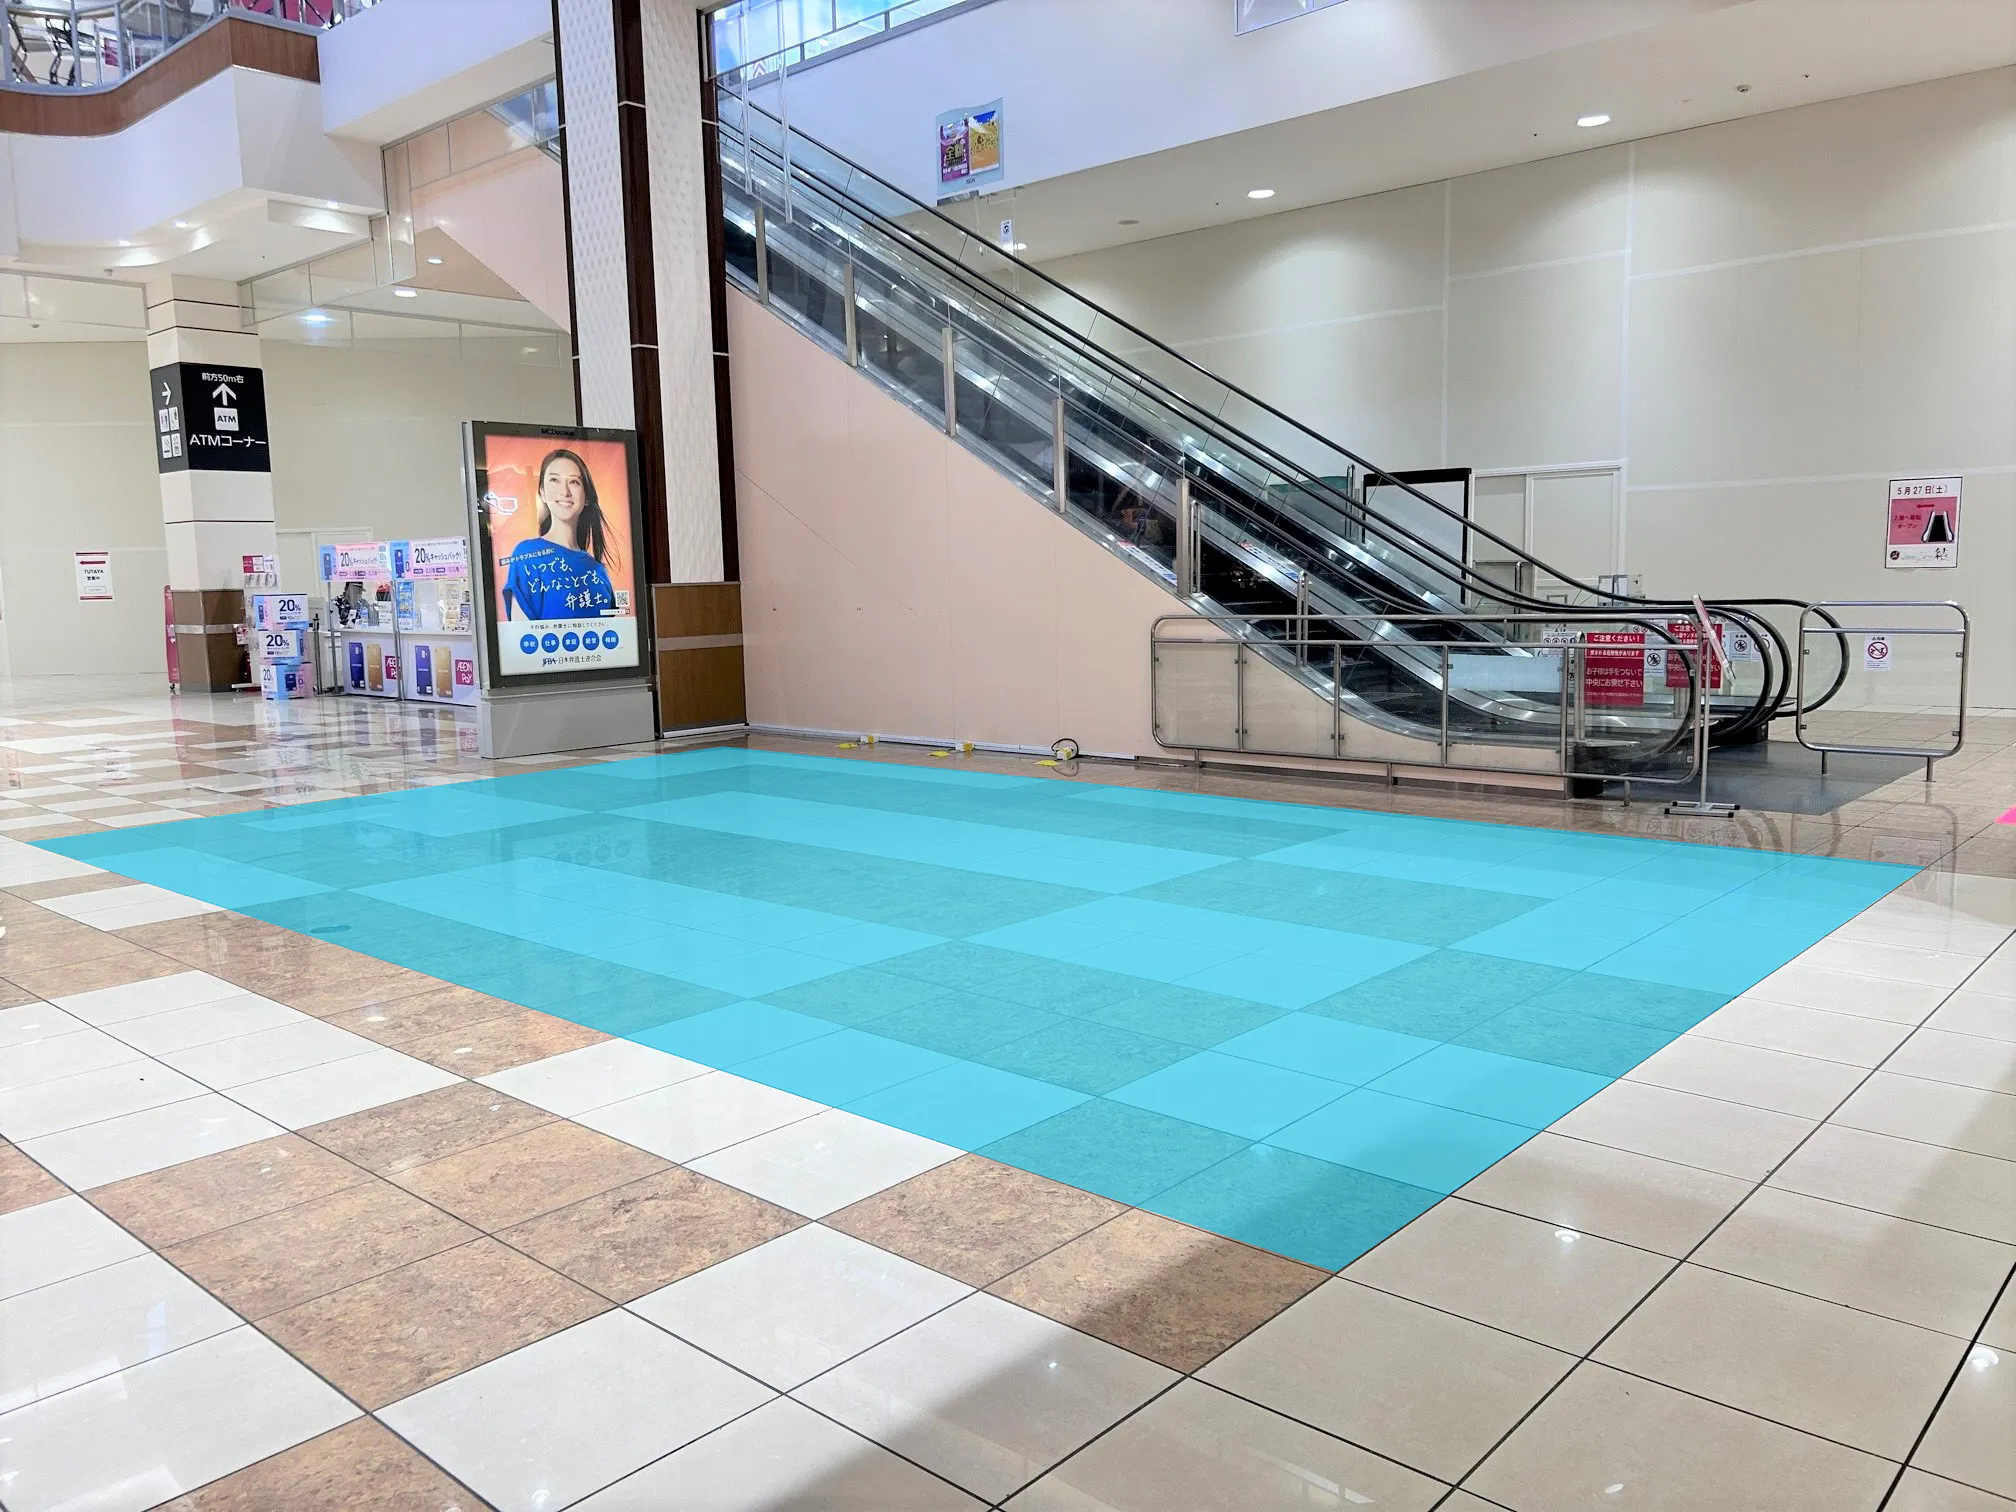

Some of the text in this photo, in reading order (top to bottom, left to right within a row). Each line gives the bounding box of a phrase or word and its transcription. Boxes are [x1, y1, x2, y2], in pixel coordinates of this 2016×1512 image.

[217, 415, 237, 423] ATM
[190, 434, 267, 447] ATMコーナー
[1897, 485, 1948, 495] 5月27日(土)
[524, 557, 573, 576] いつでも、
[528, 570, 605, 593] どんなことでも、
[279, 599, 302, 612] 20%
[565, 589, 608, 611] 弁護士。
[266, 634, 290, 647] 20%
[1593, 635, 1640, 643] ご注意ください！
[558, 654, 602, 664] 日本弁護士連合会
[1586, 678, 1643, 688] 中央にお乗せ下さい
